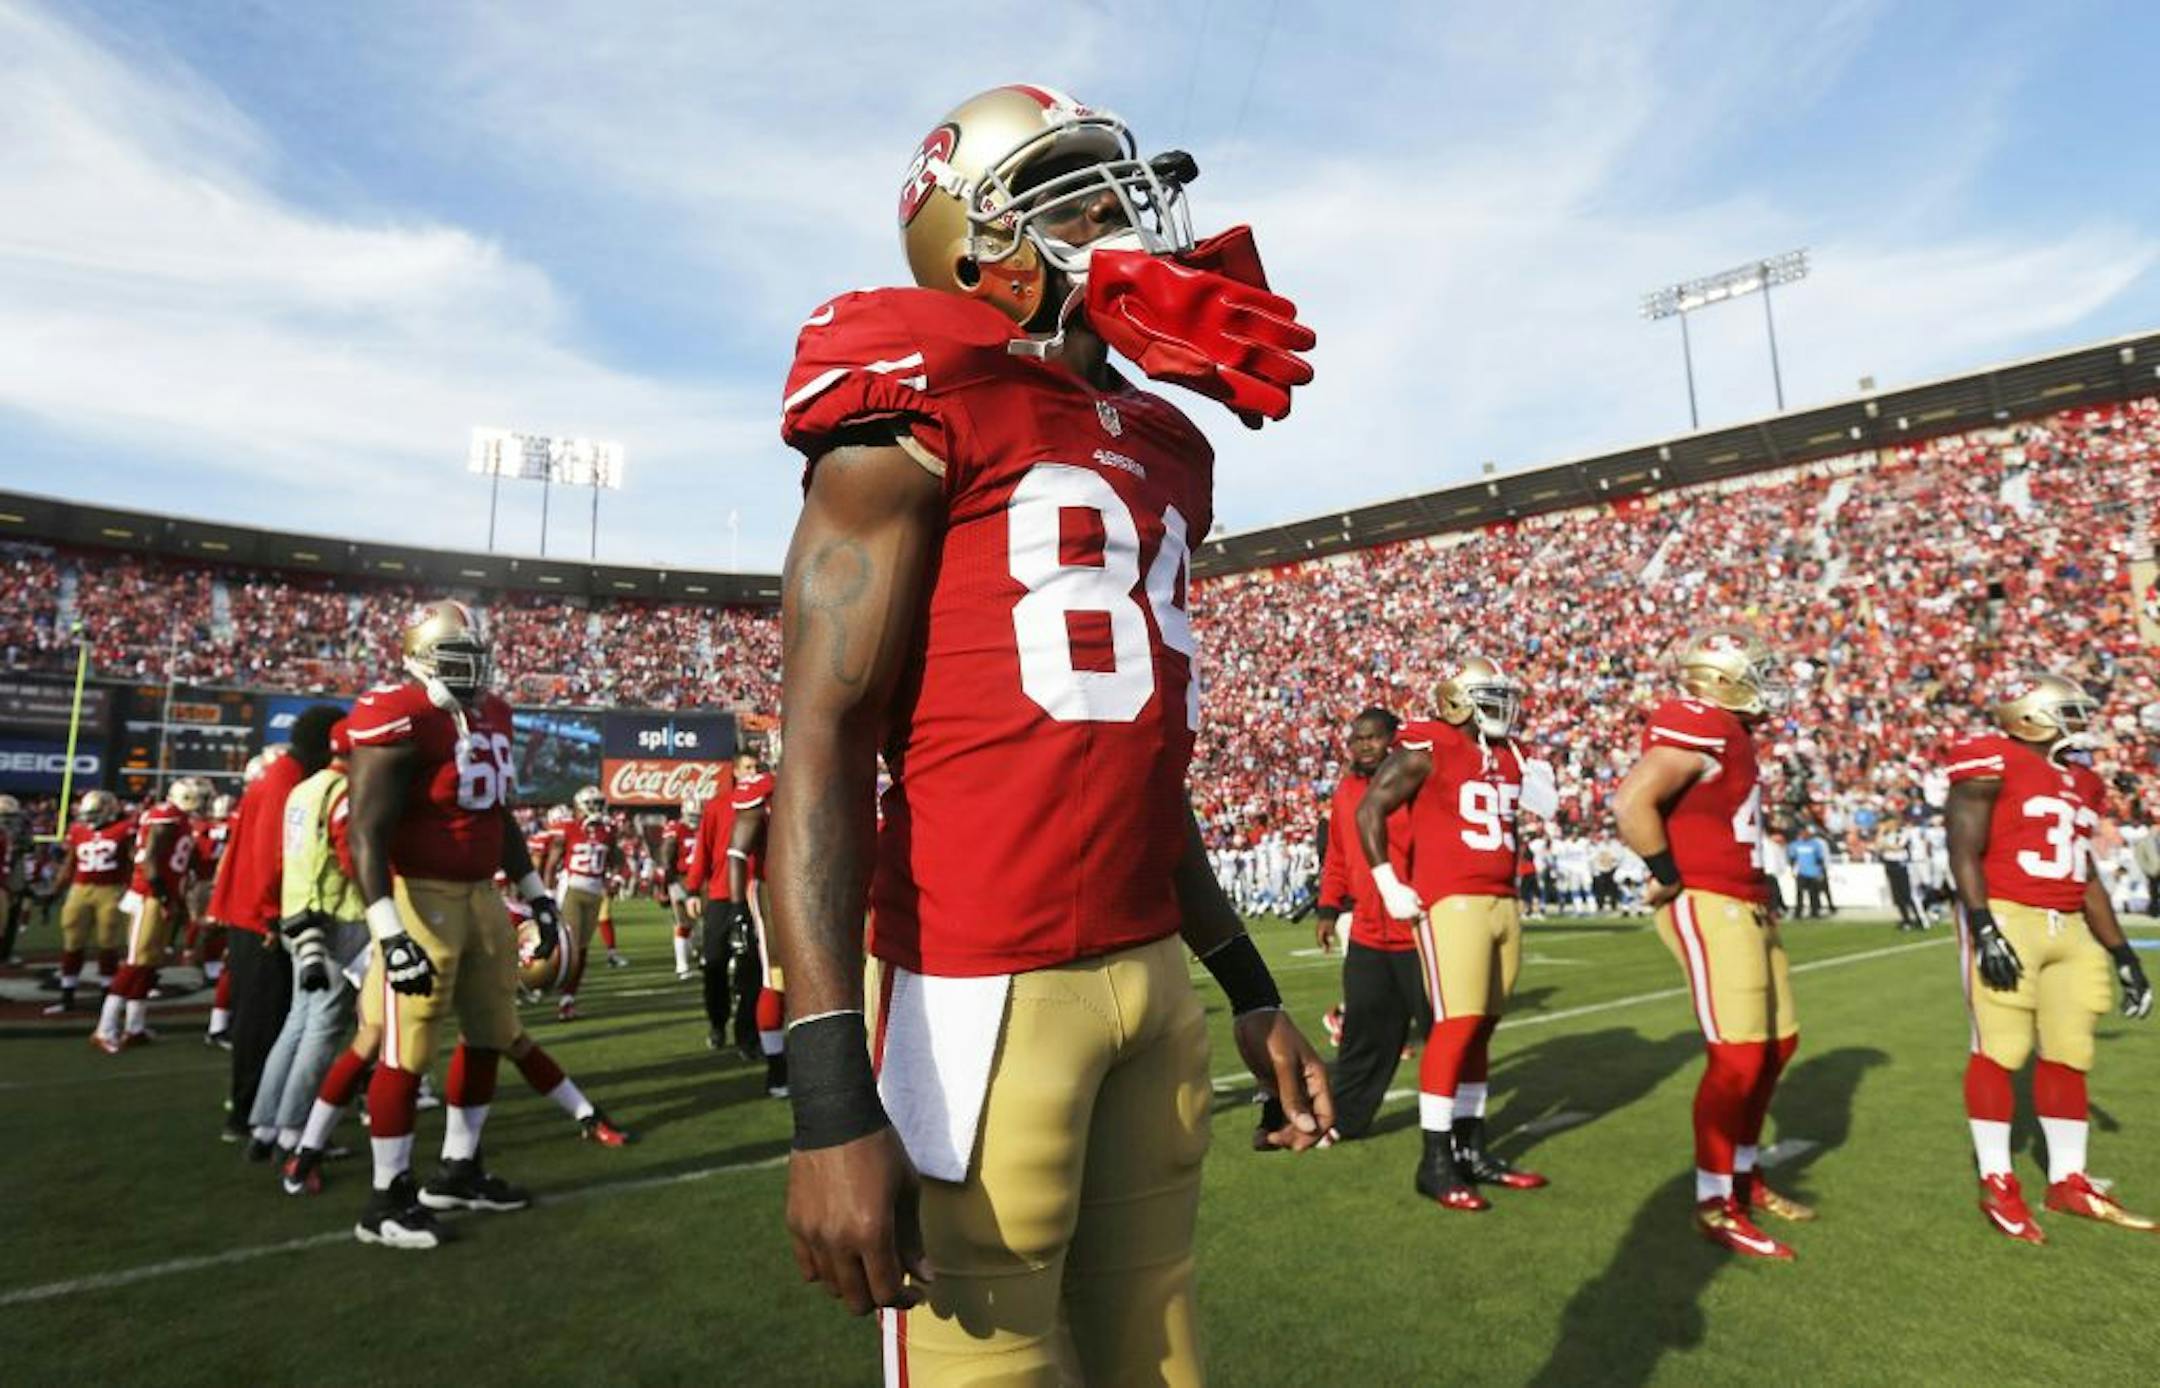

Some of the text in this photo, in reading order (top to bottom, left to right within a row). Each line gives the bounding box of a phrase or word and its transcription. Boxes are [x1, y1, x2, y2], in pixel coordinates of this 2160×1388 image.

[1008, 462, 1200, 731] 84
[455, 732, 517, 810] 68
[609, 761, 723, 801] Coca-Cola
[1459, 780, 1521, 852] 95
[2017, 795, 2098, 883] 32
[77, 839, 117, 872] 92
[569, 842, 607, 874] 20
